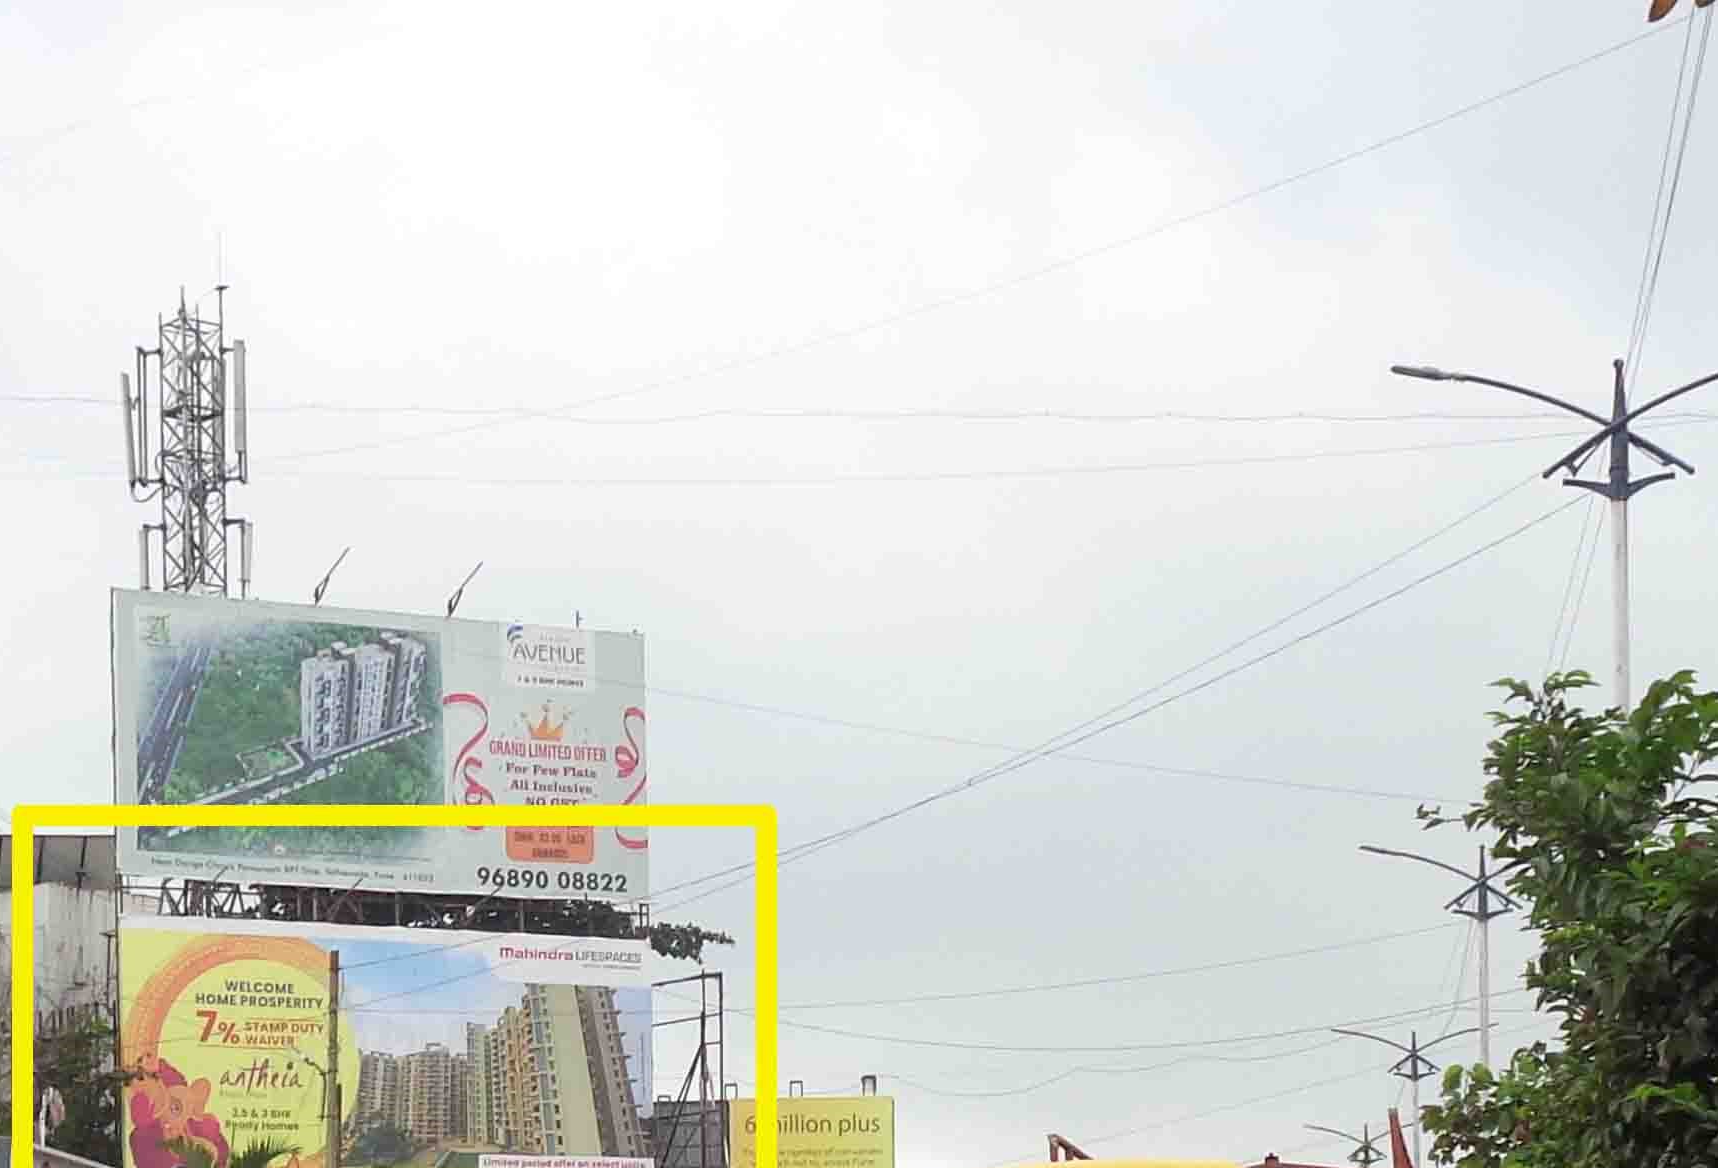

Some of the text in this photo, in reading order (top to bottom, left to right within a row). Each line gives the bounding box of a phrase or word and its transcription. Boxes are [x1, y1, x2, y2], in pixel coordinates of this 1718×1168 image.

[512, 642, 586, 665] AVENUE
[489, 739, 606, 763] GRAND LIMITED OFFER
[506, 761, 596, 779] For Few Flats
[509, 778, 593, 796] All Inclusive
[476, 866, 629, 893] 96890 08822
[575, 950, 643, 963] LIFESPACES
[224, 980, 295, 994] WELCOME
[195, 993, 325, 1009] HOME PROSPERITY
[196, 1008, 241, 1045] 7%
[243, 1021, 325, 1034] STAMP DUTY
[262, 1121, 300, 1131] Homes
[773, 1114, 832, 1133] illion
[838, 1112, 881, 1137] plus
[483, 1157, 520, 1168] Limited
[553, 1158, 576, 1168] offer
[577, 1160, 590, 1168] on
[591, 1159, 620, 1168] select
